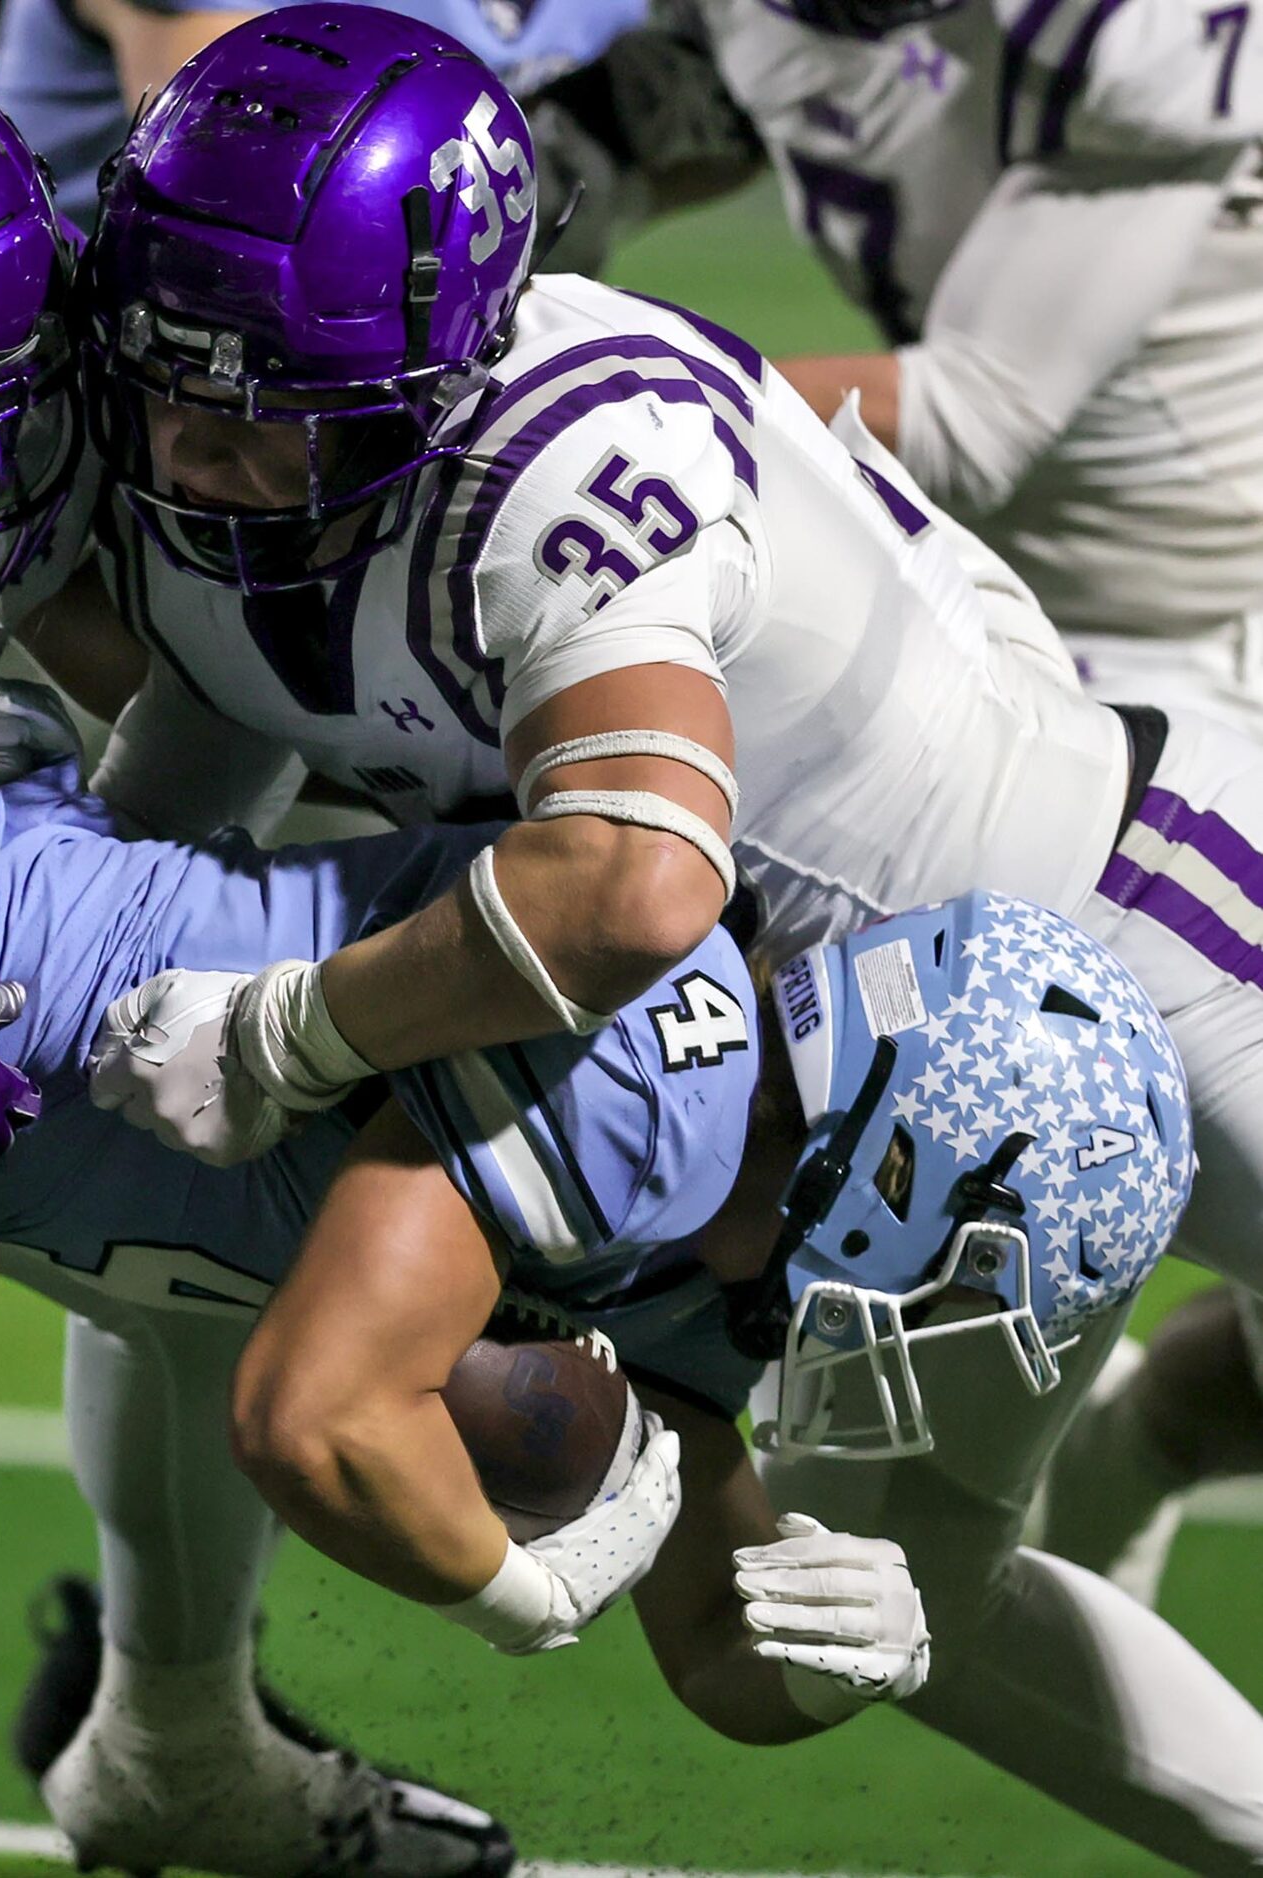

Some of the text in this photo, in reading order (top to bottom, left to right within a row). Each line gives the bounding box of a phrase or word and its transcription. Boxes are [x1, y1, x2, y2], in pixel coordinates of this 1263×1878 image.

[1202, 3, 1251, 119] 7
[430, 90, 534, 266] 35
[532, 444, 704, 618] 35
[645, 969, 749, 1074] 4
[1075, 1125, 1137, 1172] 4
